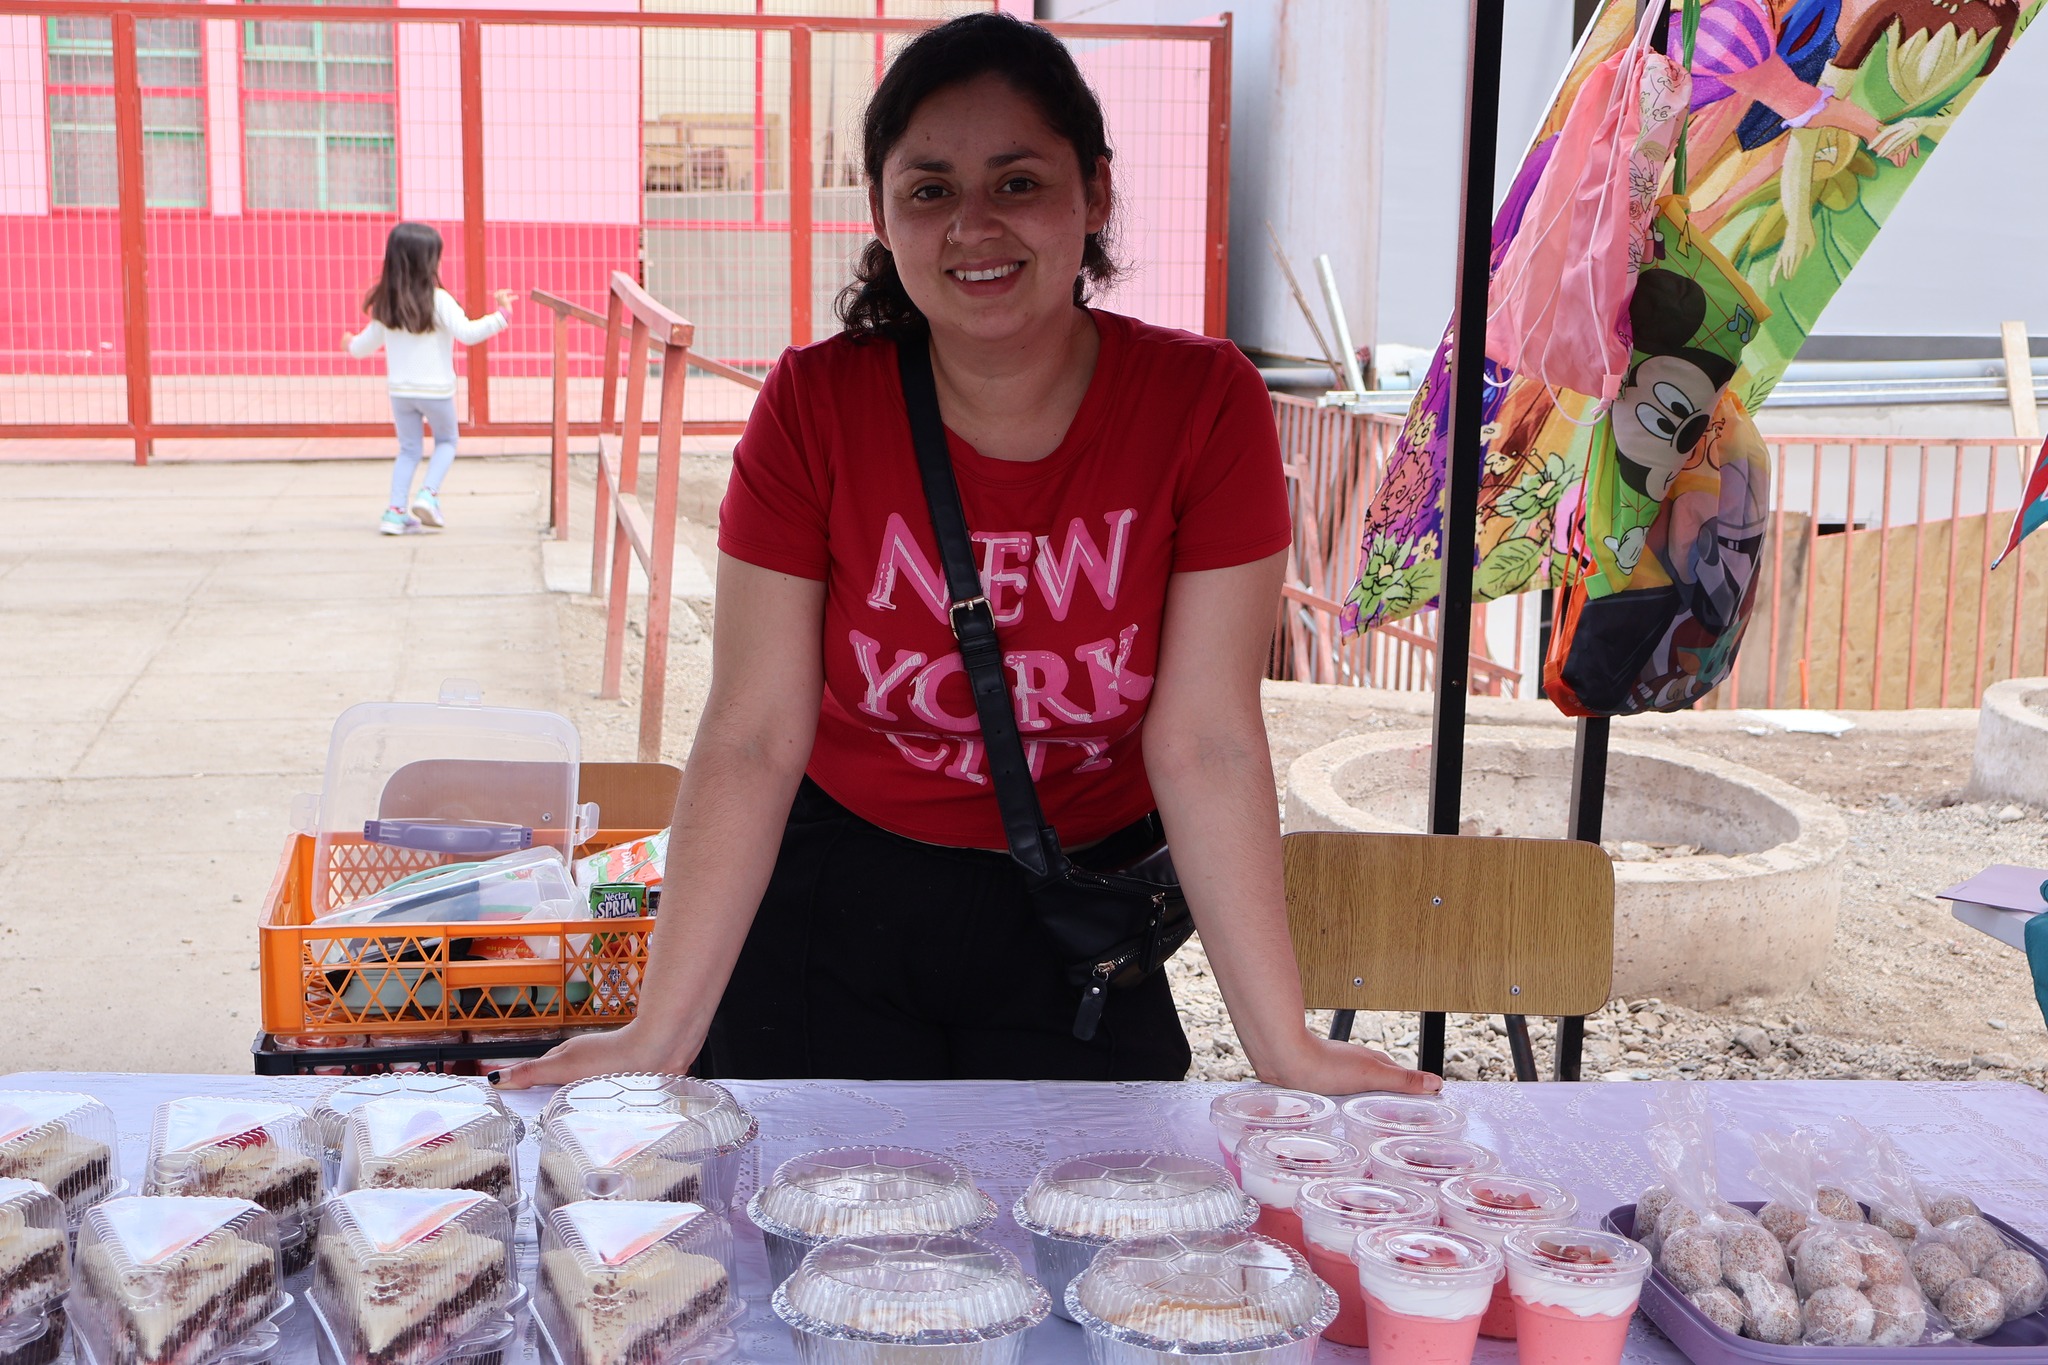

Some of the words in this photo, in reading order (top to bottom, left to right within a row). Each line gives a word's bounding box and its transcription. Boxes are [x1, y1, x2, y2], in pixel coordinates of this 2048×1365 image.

[866, 508, 1138, 625] NEW
[849, 624, 1154, 732] YORK
[597, 898, 637, 918] SPRIM
